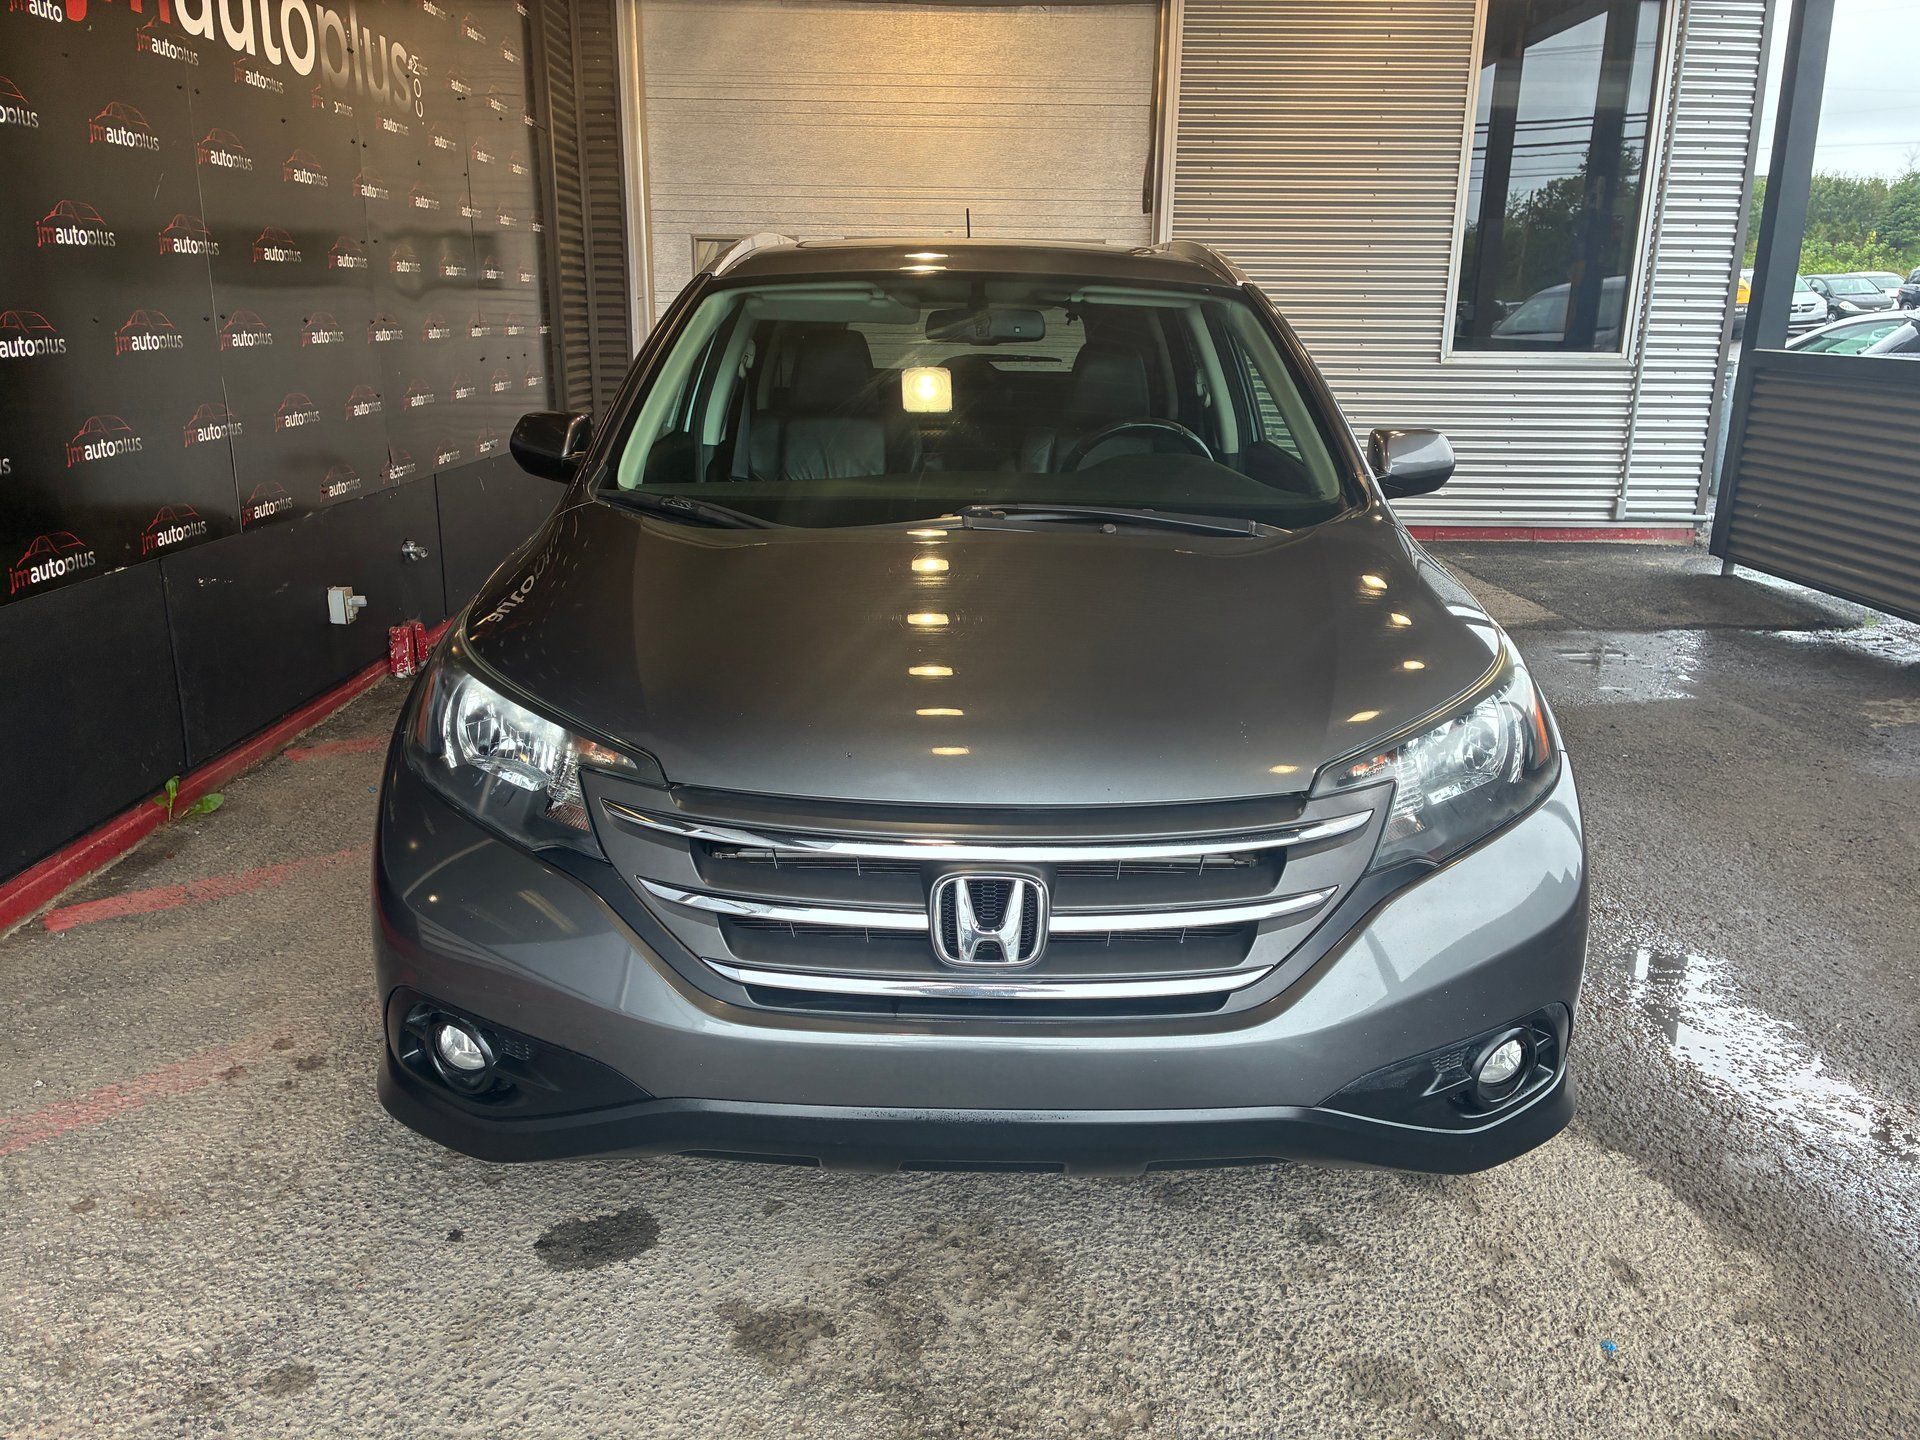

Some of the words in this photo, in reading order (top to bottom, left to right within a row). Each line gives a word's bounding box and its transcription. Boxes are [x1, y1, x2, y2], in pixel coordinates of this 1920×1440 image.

[136, 28, 199, 66] jmautoplus
[233, 60, 284, 94] jmautoplus
[89, 119, 159, 151] jmautoplus
[197, 142, 253, 171] jmautoplus
[283, 162, 328, 187] jmautoplus
[36, 221, 116, 248] jmautoplus
[158, 233, 220, 257] jmautoplus
[252, 242, 302, 263] jmautoplus
[114, 331, 184, 357] jmautoplus
[219, 329, 273, 352] jmautoplus
[301, 329, 345, 348] jmautoplus
[183, 421, 243, 449] jmautoplus
[274, 409, 320, 433] jmautoplus
[65, 436, 143, 468] jmautoplus
[242, 495, 293, 525] jmautoplus
[141, 519, 207, 555] jmautoplus
[9, 549, 96, 594] jmautoplus
